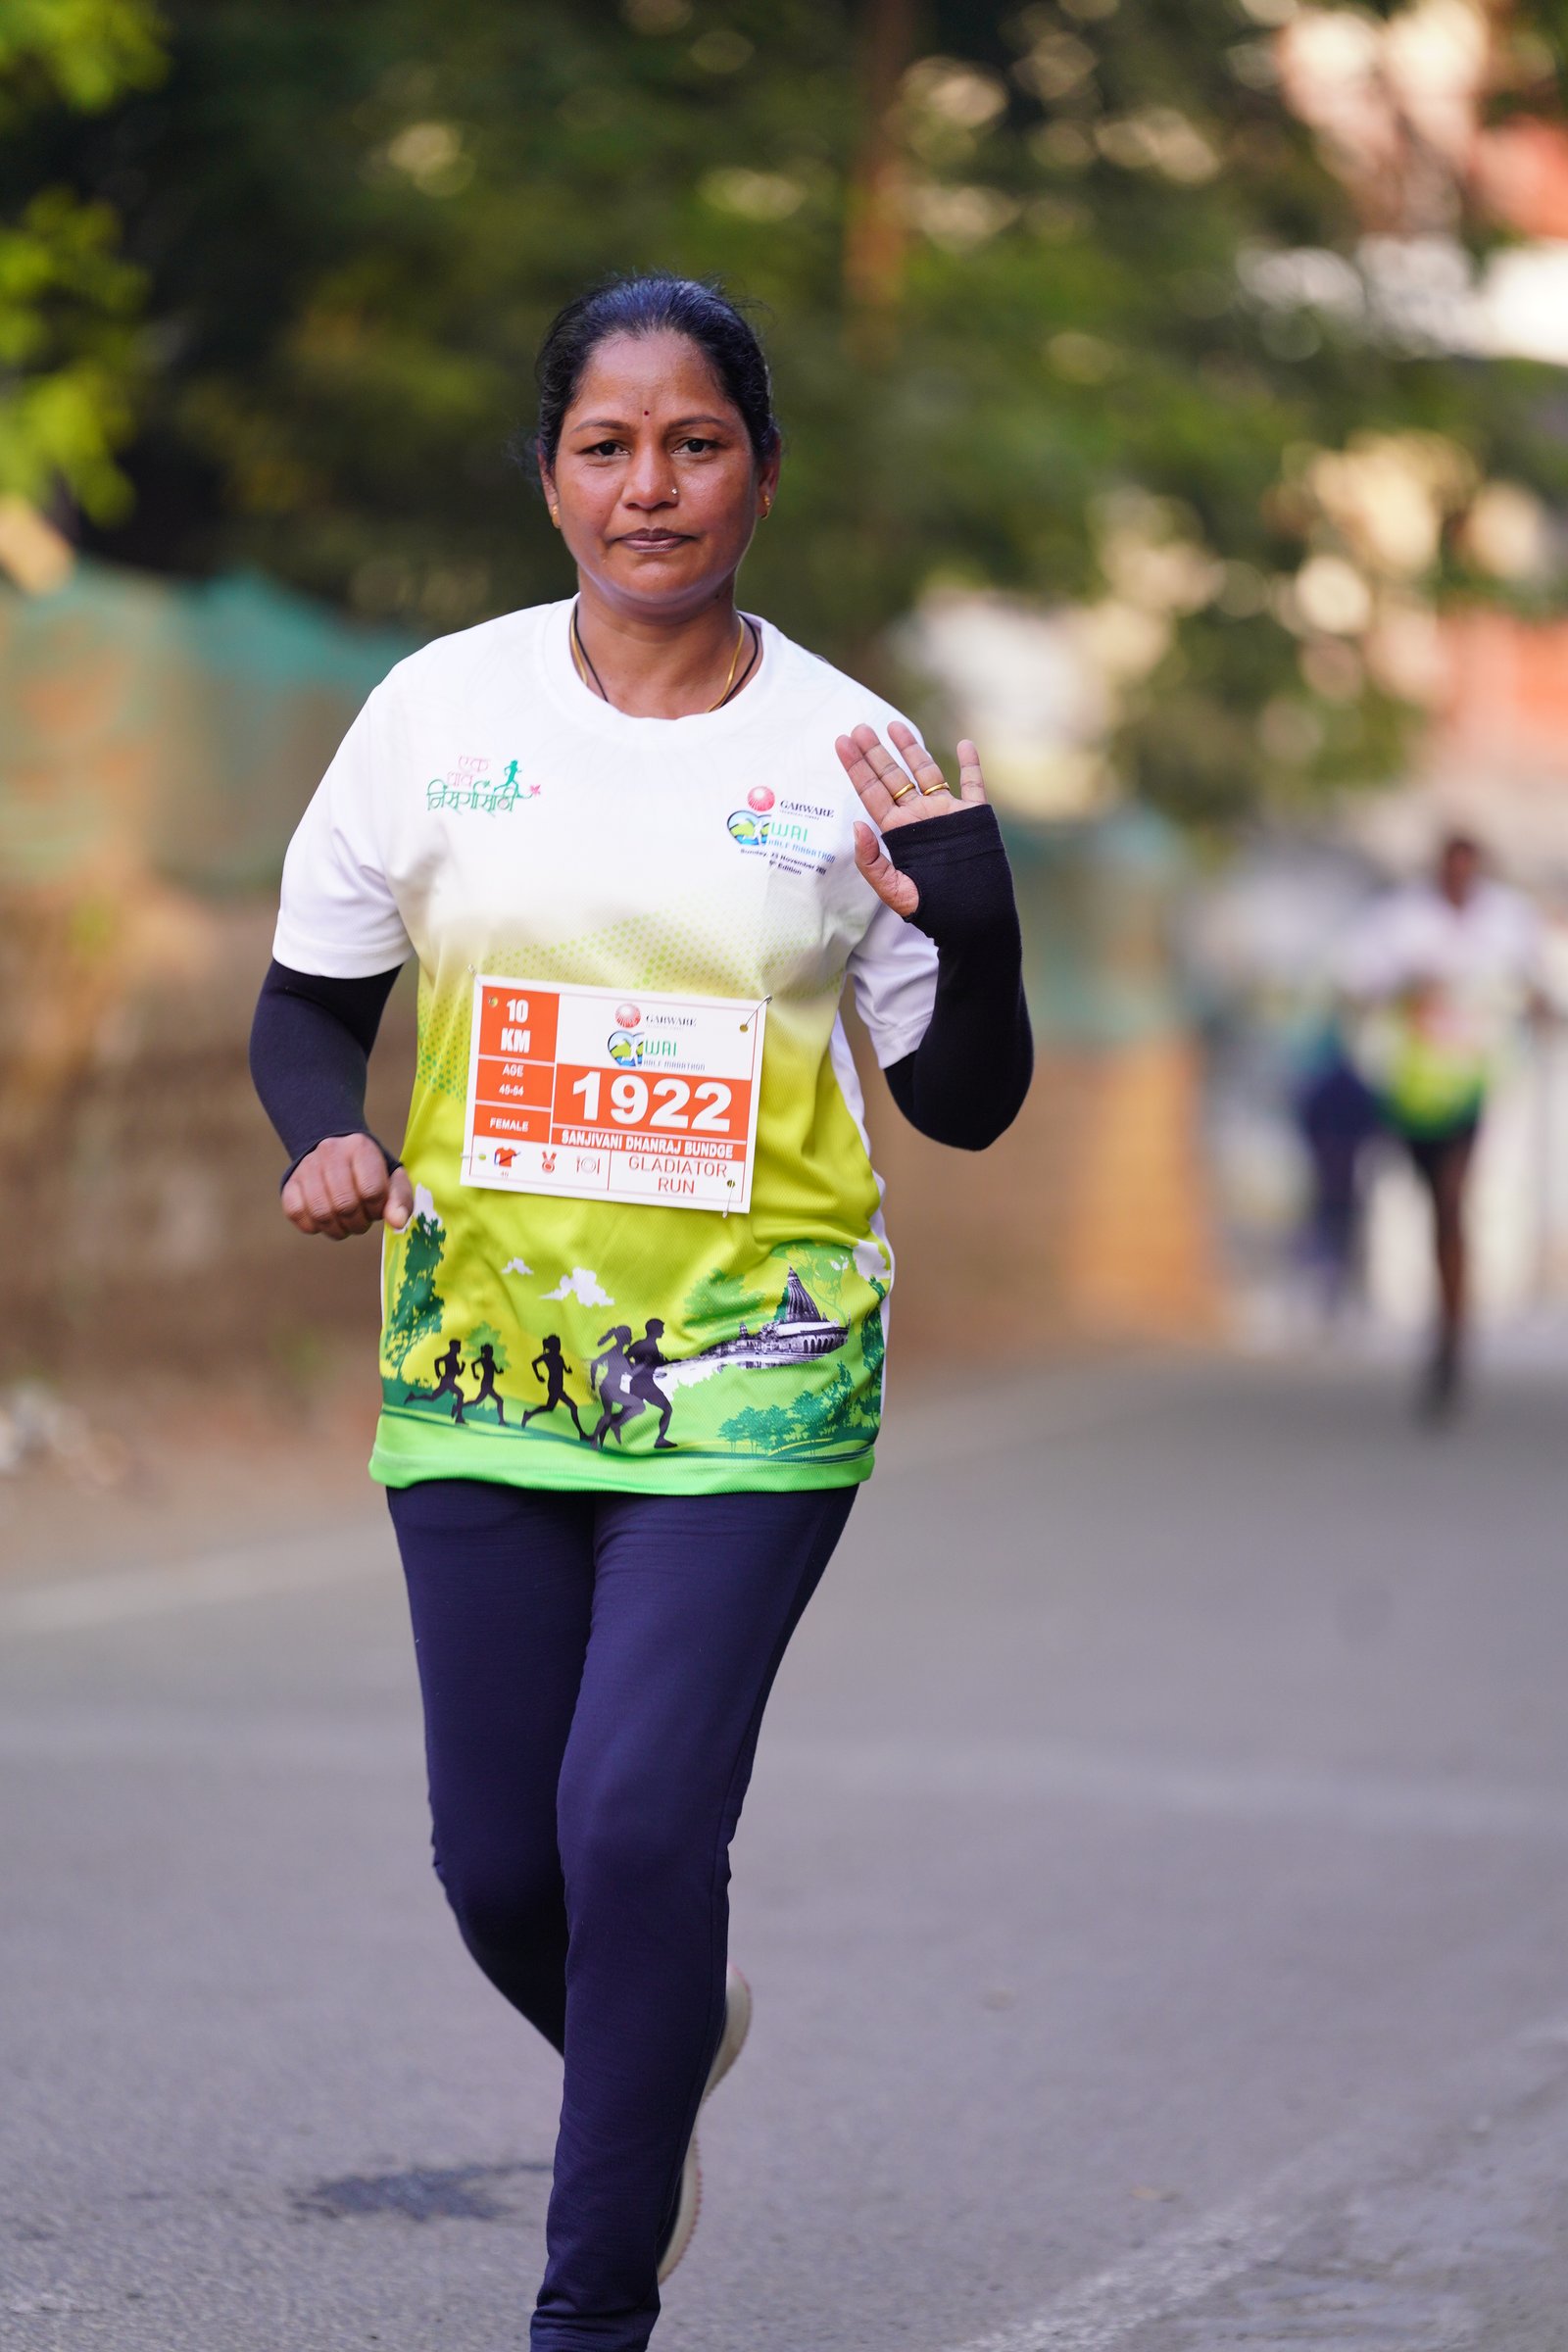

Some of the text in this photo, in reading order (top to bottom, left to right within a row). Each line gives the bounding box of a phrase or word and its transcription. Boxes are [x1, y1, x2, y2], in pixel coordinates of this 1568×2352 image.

[780, 800, 835, 818] GARWARE
[770, 821, 808, 842] WAI
[506, 999, 529, 1024] 10
[646, 1014, 697, 1027] GARWARE
[501, 1028, 530, 1054] KM
[644, 1039, 677, 1056] WAI
[502, 1064, 524, 1077] AGE
[572, 1071, 732, 1132] 1922
[489, 1118, 529, 1132] FEMALE
[562, 1129, 734, 1158] SANJIVANI DHANRAJ BUNDGE
[628, 1156, 727, 1177] GLADIATOR
[658, 1177, 695, 1195] RUN
